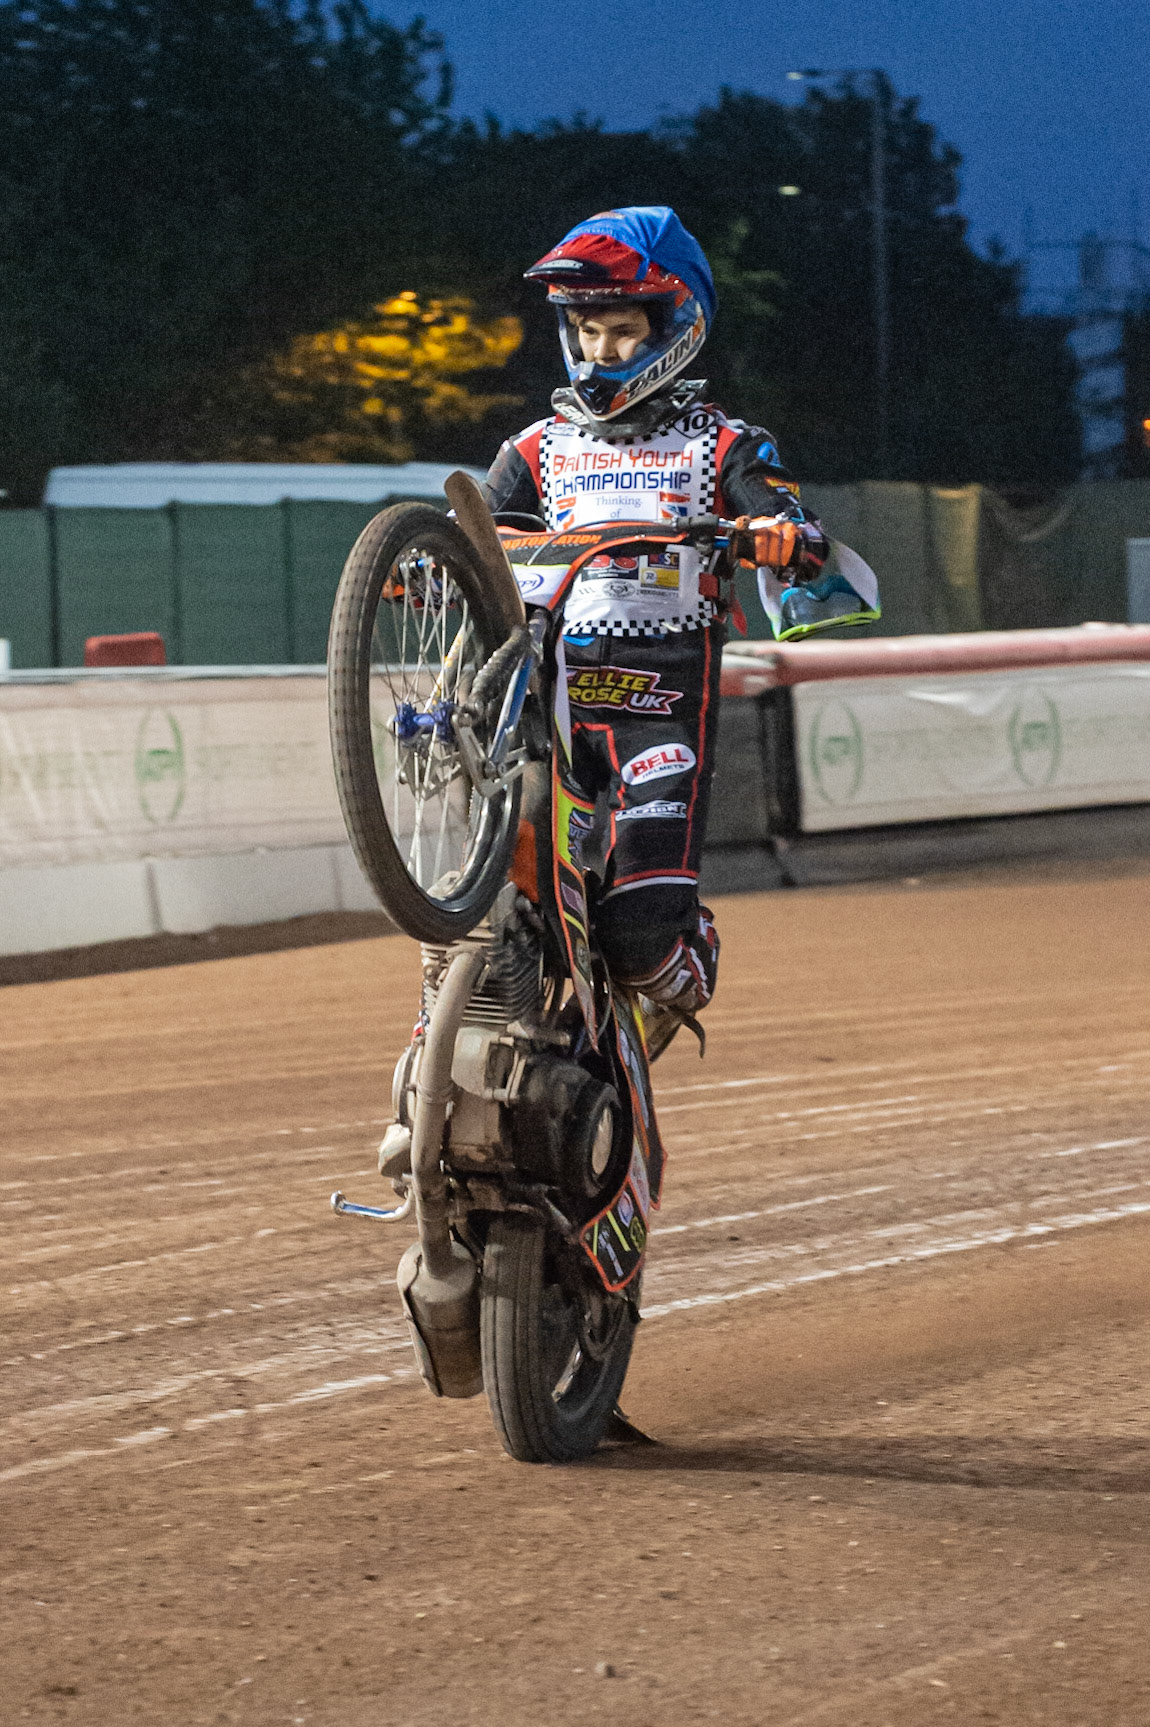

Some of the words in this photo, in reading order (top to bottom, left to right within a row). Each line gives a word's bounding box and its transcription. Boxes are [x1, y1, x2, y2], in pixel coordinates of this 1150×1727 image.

[681, 414, 709, 432] 10
[553, 452, 623, 476] BRITISH
[628, 448, 693, 468] YOUTH
[555, 471, 691, 498] CHAMPIONSHIP
[595, 494, 642, 506] Thinking
[609, 508, 622, 519] of
[576, 672, 650, 692] ELLIE
[568, 687, 623, 704] ROSE
[630, 693, 667, 709] UK
[630, 748, 689, 778] BELL
